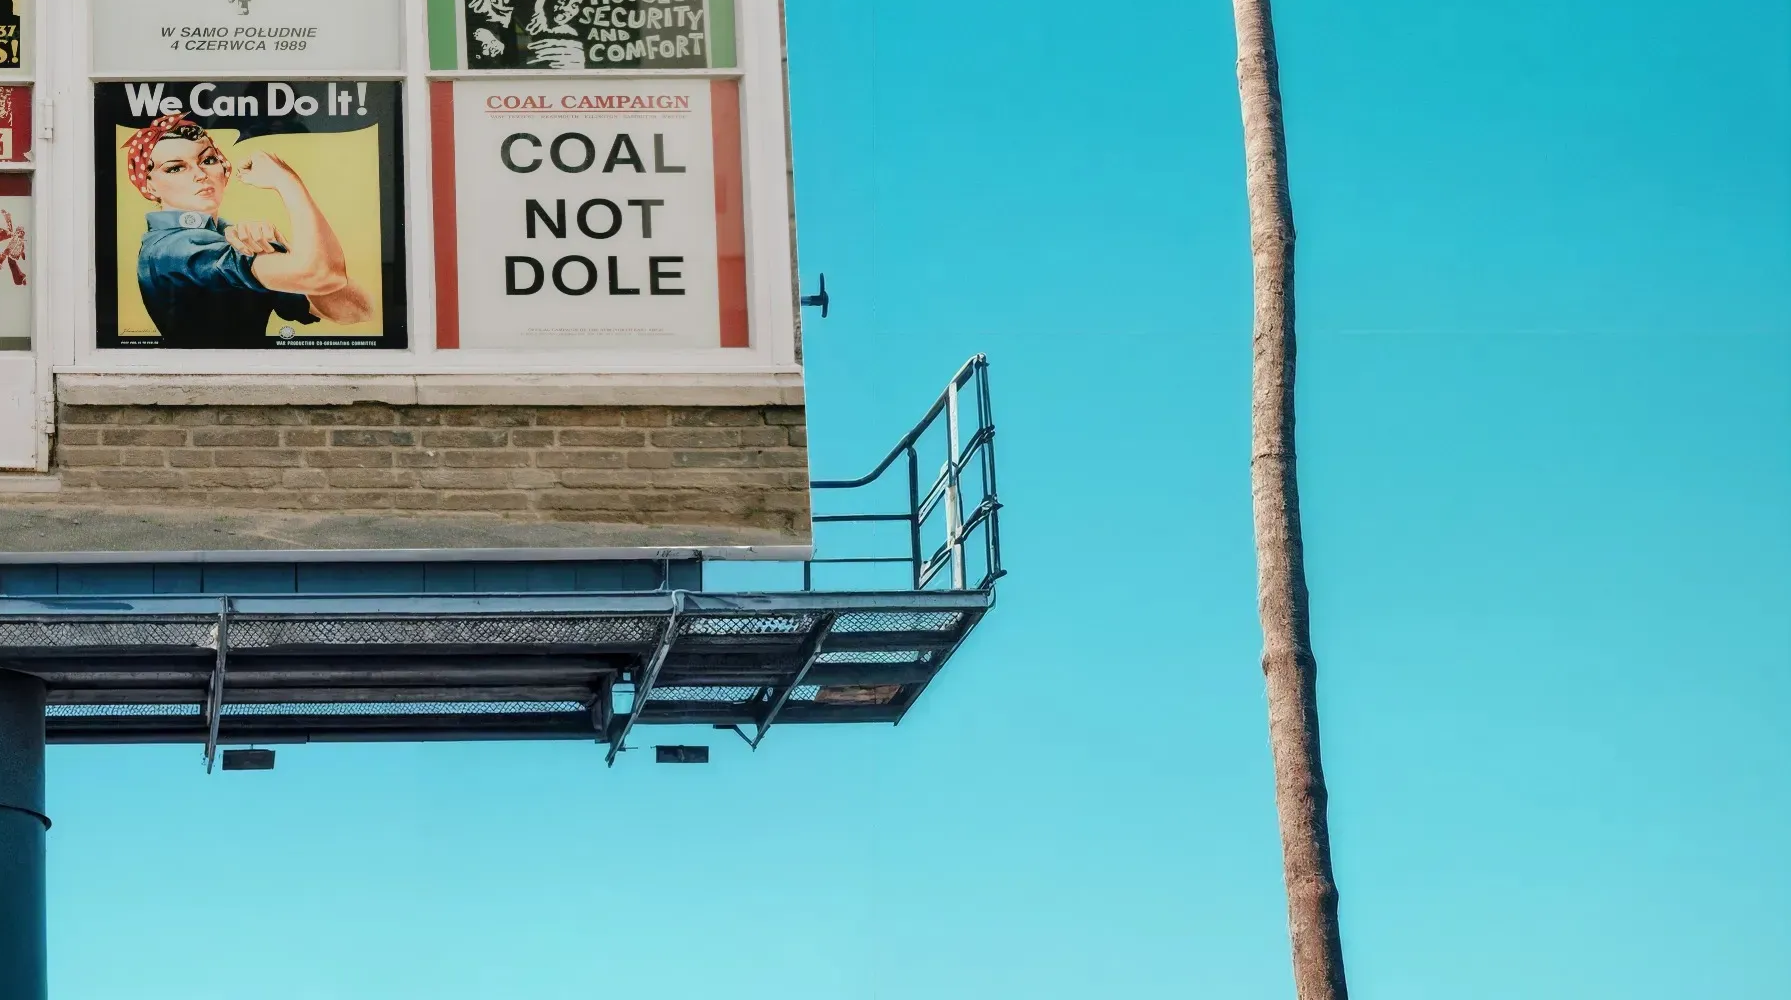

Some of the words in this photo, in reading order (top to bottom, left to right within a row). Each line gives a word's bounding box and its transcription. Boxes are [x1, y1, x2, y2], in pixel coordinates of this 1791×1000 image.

[579, 6, 704, 30] SECURITY
[161, 28, 176, 37] W
[180, 27, 229, 38] SAMO
[234, 27, 318, 38] POŁUDNIE
[171, 41, 179, 50] 4
[185, 40, 266, 51] CZERWCA
[274, 41, 307, 51] 1989
[587, 28, 630, 42] AND
[589, 33, 704, 61] COMFORT
[124, 82, 184, 117] We
[189, 82, 259, 117] Can
[267, 82, 319, 117] Do
[328, 82, 368, 116] It!
[486, 95, 553, 109] COAL
[560, 95, 690, 109] CAMPAIGN
[500, 132, 686, 174] COAL
[525, 198, 664, 239] NOT
[504, 255, 686, 296] DOLE
